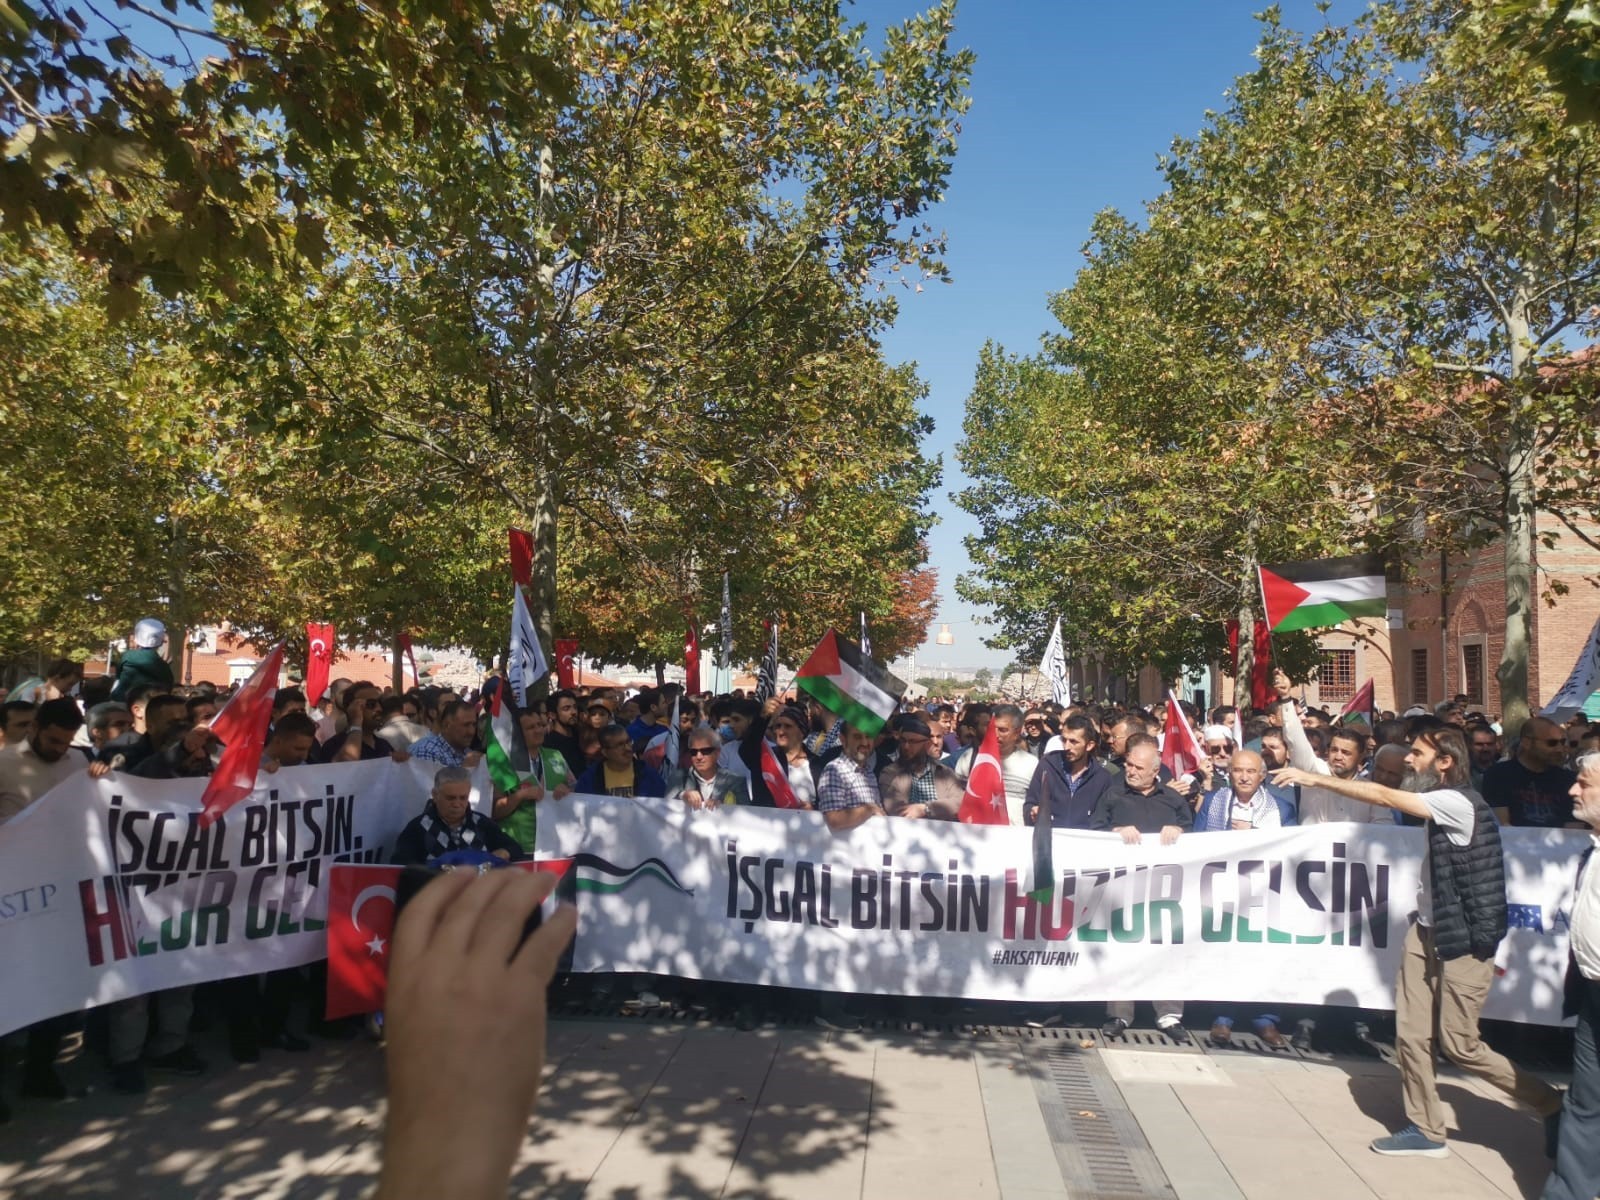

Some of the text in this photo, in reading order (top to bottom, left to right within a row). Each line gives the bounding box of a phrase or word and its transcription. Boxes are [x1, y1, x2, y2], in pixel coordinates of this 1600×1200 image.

[240, 784, 354, 868] BİTSİN
[726, 839, 1390, 949] İŞGAL BİTSİN HUZUR GELSİN
[992, 949, 1080, 967] #AKSATUFANI
